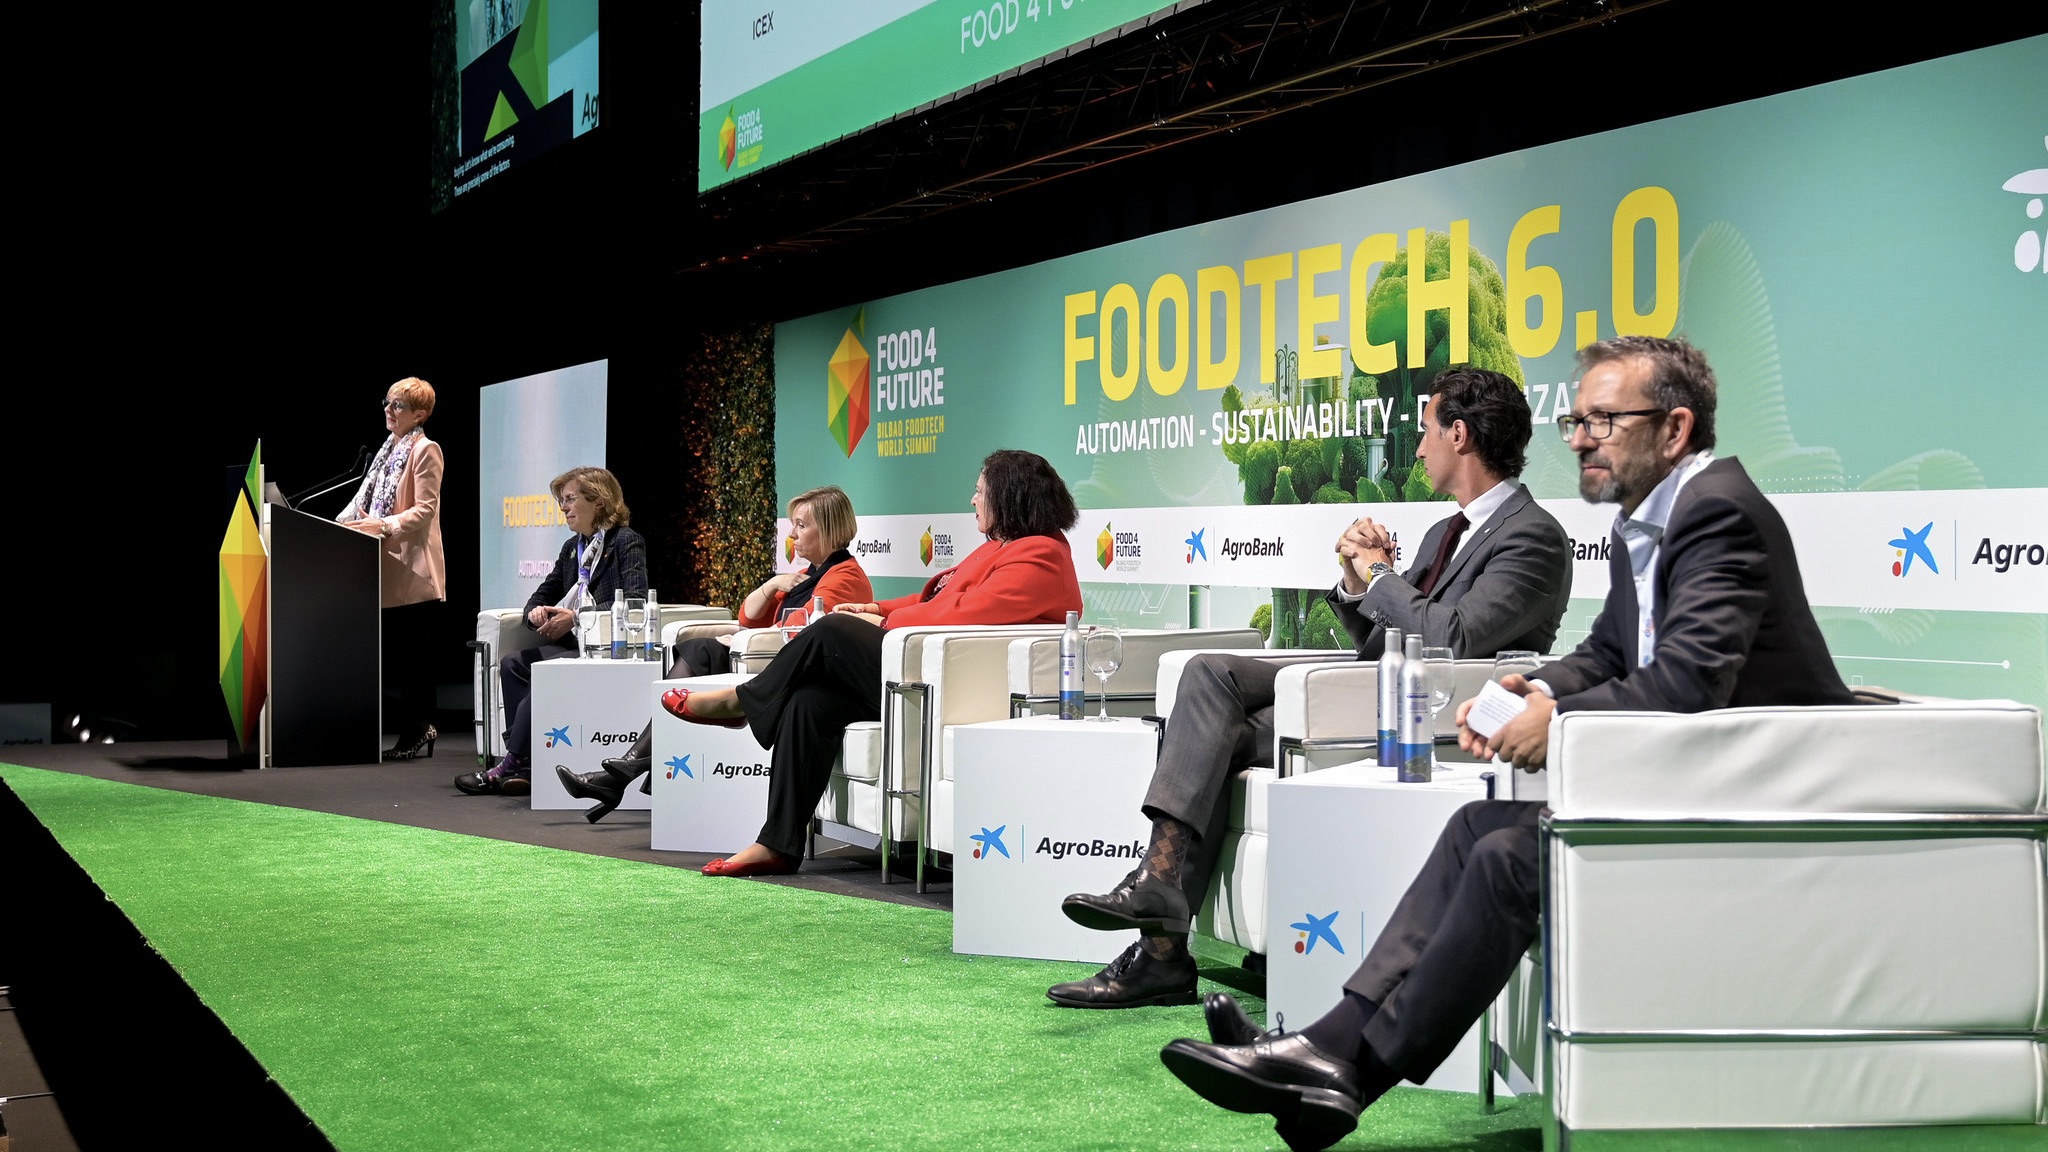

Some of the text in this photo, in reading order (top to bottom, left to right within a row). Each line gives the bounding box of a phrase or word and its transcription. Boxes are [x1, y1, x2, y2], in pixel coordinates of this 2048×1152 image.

[753, 10, 774, 40] ICEX
[961, 0, 1019, 53] FOOD
[737, 110, 755, 132] FOOD
[737, 124, 763, 150] FUTURE
[1065, 186, 1679, 406] FOODTECH 6.0
[877, 327, 937, 372] FOOD 4
[877, 367, 944, 412] FUTURE
[877, 415, 944, 439] BILBAO FOODTECH
[1076, 414, 1194, 455] AUTOMATION
[1211, 397, 1394, 446] SUSTAINABILITY
[877, 435, 937, 457] WORLD SUMMIT
[503, 494, 554, 528] FOODTECH
[856, 538, 891, 557] AgroBank
[934, 534, 948, 545] FOOD
[934, 545, 954, 556] FUTURE
[1115, 532, 1133, 545] FOOD
[1221, 536, 1284, 561] AgroBank
[1115, 545, 1141, 557] FUTURE
[1971, 537, 2048, 573] Agro
[591, 731, 639, 746] AgroB
[712, 762, 772, 779] AgroBa
[1035, 837, 1145, 860] AgroBank
